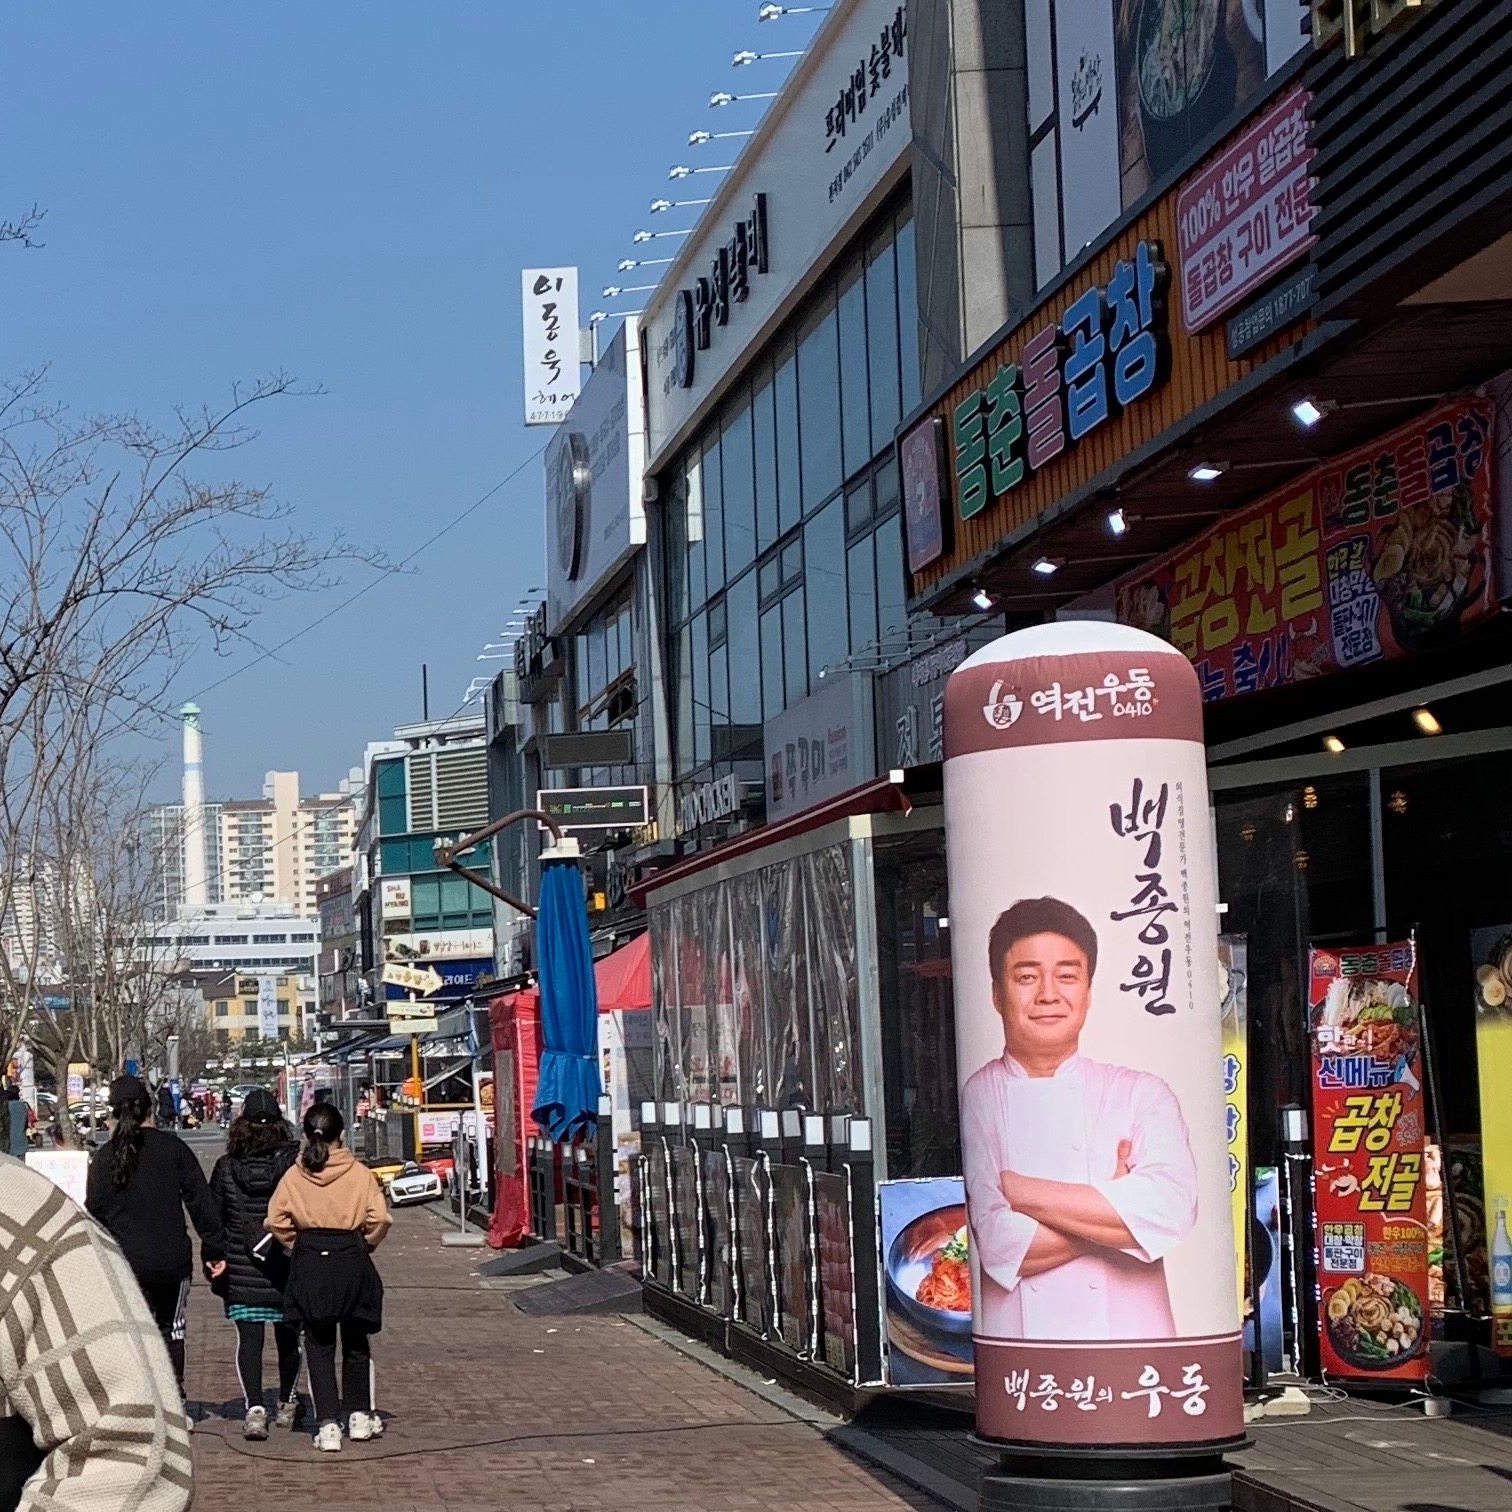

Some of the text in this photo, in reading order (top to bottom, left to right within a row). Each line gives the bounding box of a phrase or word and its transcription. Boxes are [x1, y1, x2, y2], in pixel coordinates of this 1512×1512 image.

[869, 6, 907, 98] 숯불화
[1180, 188, 1220, 249] 100%
[1221, 151, 1254, 216] 한우
[1187, 236, 1233, 312] 돌곱창
[1237, 203, 1271, 268] 구이
[1031, 668, 1155, 722] 역전우동
[1113, 702, 1153, 717] 0410
[1110, 778, 1178, 1016] 백종원
[1317, 1055, 1395, 1089] 신메뉴
[1327, 1093, 1403, 1152] 곱창
[1358, 1152, 1422, 1213] 전골
[1004, 1363, 1210, 1418] 백종원의 우동
